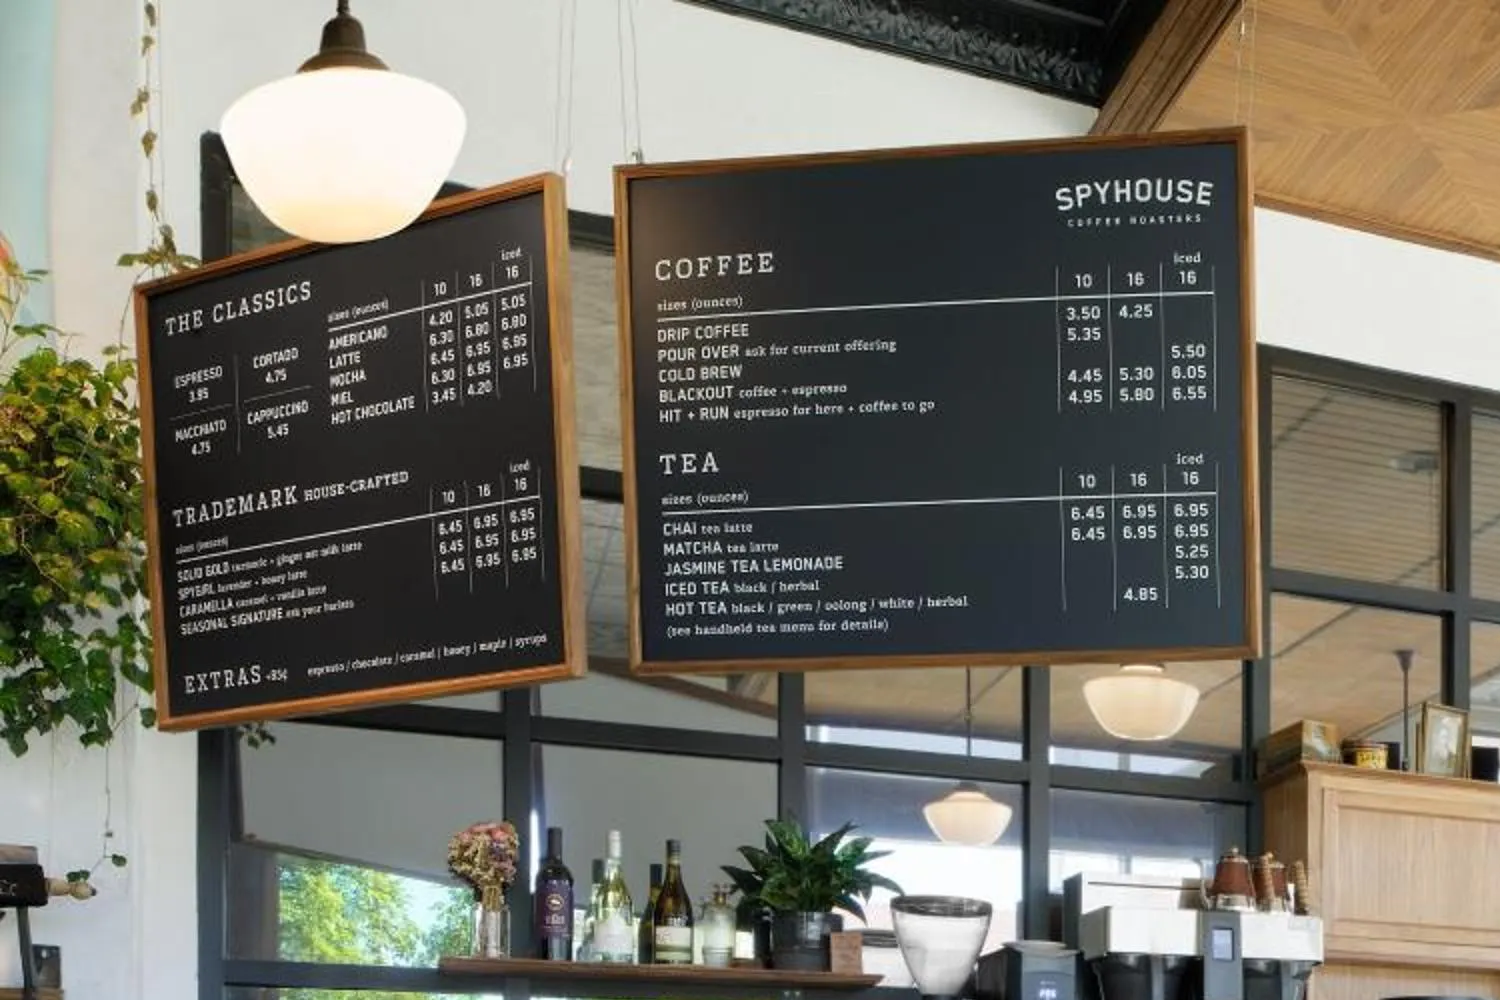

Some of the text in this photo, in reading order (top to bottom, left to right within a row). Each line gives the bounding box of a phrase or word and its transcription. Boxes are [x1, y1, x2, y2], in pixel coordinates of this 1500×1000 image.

[1056, 178, 1213, 211] SPYHOUSE
[655, 252, 773, 281] COFFEE
[1173, 252, 1201, 263] iced
[434, 265, 519, 296] 10 16 16
[657, 270, 1197, 311] sizes (ounces) 10 16 16
[165, 281, 311, 336] THE CLASSICS
[329, 293, 526, 350] AMERICANO 4.20 5.05 5.05
[657, 303, 1153, 343] DRIP COFFEE 3.50 4.25
[253, 347, 299, 369] CORTADO
[329, 350, 361, 369] LATTE
[657, 347, 696, 362] POUR
[701, 344, 739, 359] OVER
[769, 343, 789, 356] for
[792, 343, 840, 355] current
[844, 339, 897, 353] offering
[1067, 327, 1101, 341] 5.35
[175, 365, 223, 389] ESPRESSO
[330, 369, 367, 387] MOCHA
[430, 348, 455, 365] 6.45
[465, 341, 491, 358] 6.95
[658, 343, 1206, 383] COLD BREW 5.50
[331, 391, 354, 406] MIEL
[503, 353, 529, 369] 6.95
[659, 385, 734, 403] BLACKOUT
[739, 385, 777, 399] coffee
[1067, 368, 1103, 383] 4.45
[1119, 366, 1154, 381] 5.30
[1171, 365, 1207, 379] 6.05
[247, 400, 309, 425] CAPPUCCINO
[331, 409, 352, 425] HOT
[355, 395, 415, 420] CHOCOLATE
[432, 387, 457, 404] 3.45
[659, 408, 682, 423] HIT
[699, 406, 729, 420] RUN
[793, 404, 811, 416] for
[815, 403, 844, 415] here
[859, 400, 898, 413] coffee
[901, 401, 915, 411] to
[919, 401, 935, 413] go
[1068, 389, 1103, 404] 4.95
[1119, 387, 1155, 402] 5.80
[1172, 385, 1207, 401] 6.55
[175, 419, 227, 442] MACCHIATO
[659, 451, 719, 475] TEA
[1176, 453, 1204, 465] iced
[442, 477, 527, 503] 10 16 16
[1078, 474, 1096, 489] 10
[1130, 472, 1147, 487] 16
[1183, 471, 1199, 485] 16
[173, 471, 409, 527] TRADEMARK HOUSE-CRAFTED
[511, 527, 537, 543] 6.95
[663, 503, 1209, 536] CHAI tea latte 6.45 6.95 6.95
[663, 541, 723, 556] MATCHA
[1071, 526, 1105, 541] 6.45
[1123, 525, 1157, 539] 6.95
[1174, 523, 1209, 538] 6.95
[665, 543, 1209, 576] JASMINE TEA LEMONADE 5.25
[665, 565, 1209, 597] ICED TEA black herbal 5.30
[665, 601, 694, 616] HOT
[699, 601, 727, 615] TEA
[731, 602, 765, 614] black
[777, 603, 813, 615] green
[879, 597, 915, 609] white
[927, 595, 968, 607] herbal
[1123, 587, 1158, 601] 4.85
[756, 624, 776, 633] tea
[818, 620, 837, 631] for
[185, 665, 261, 694] EXTRAS
